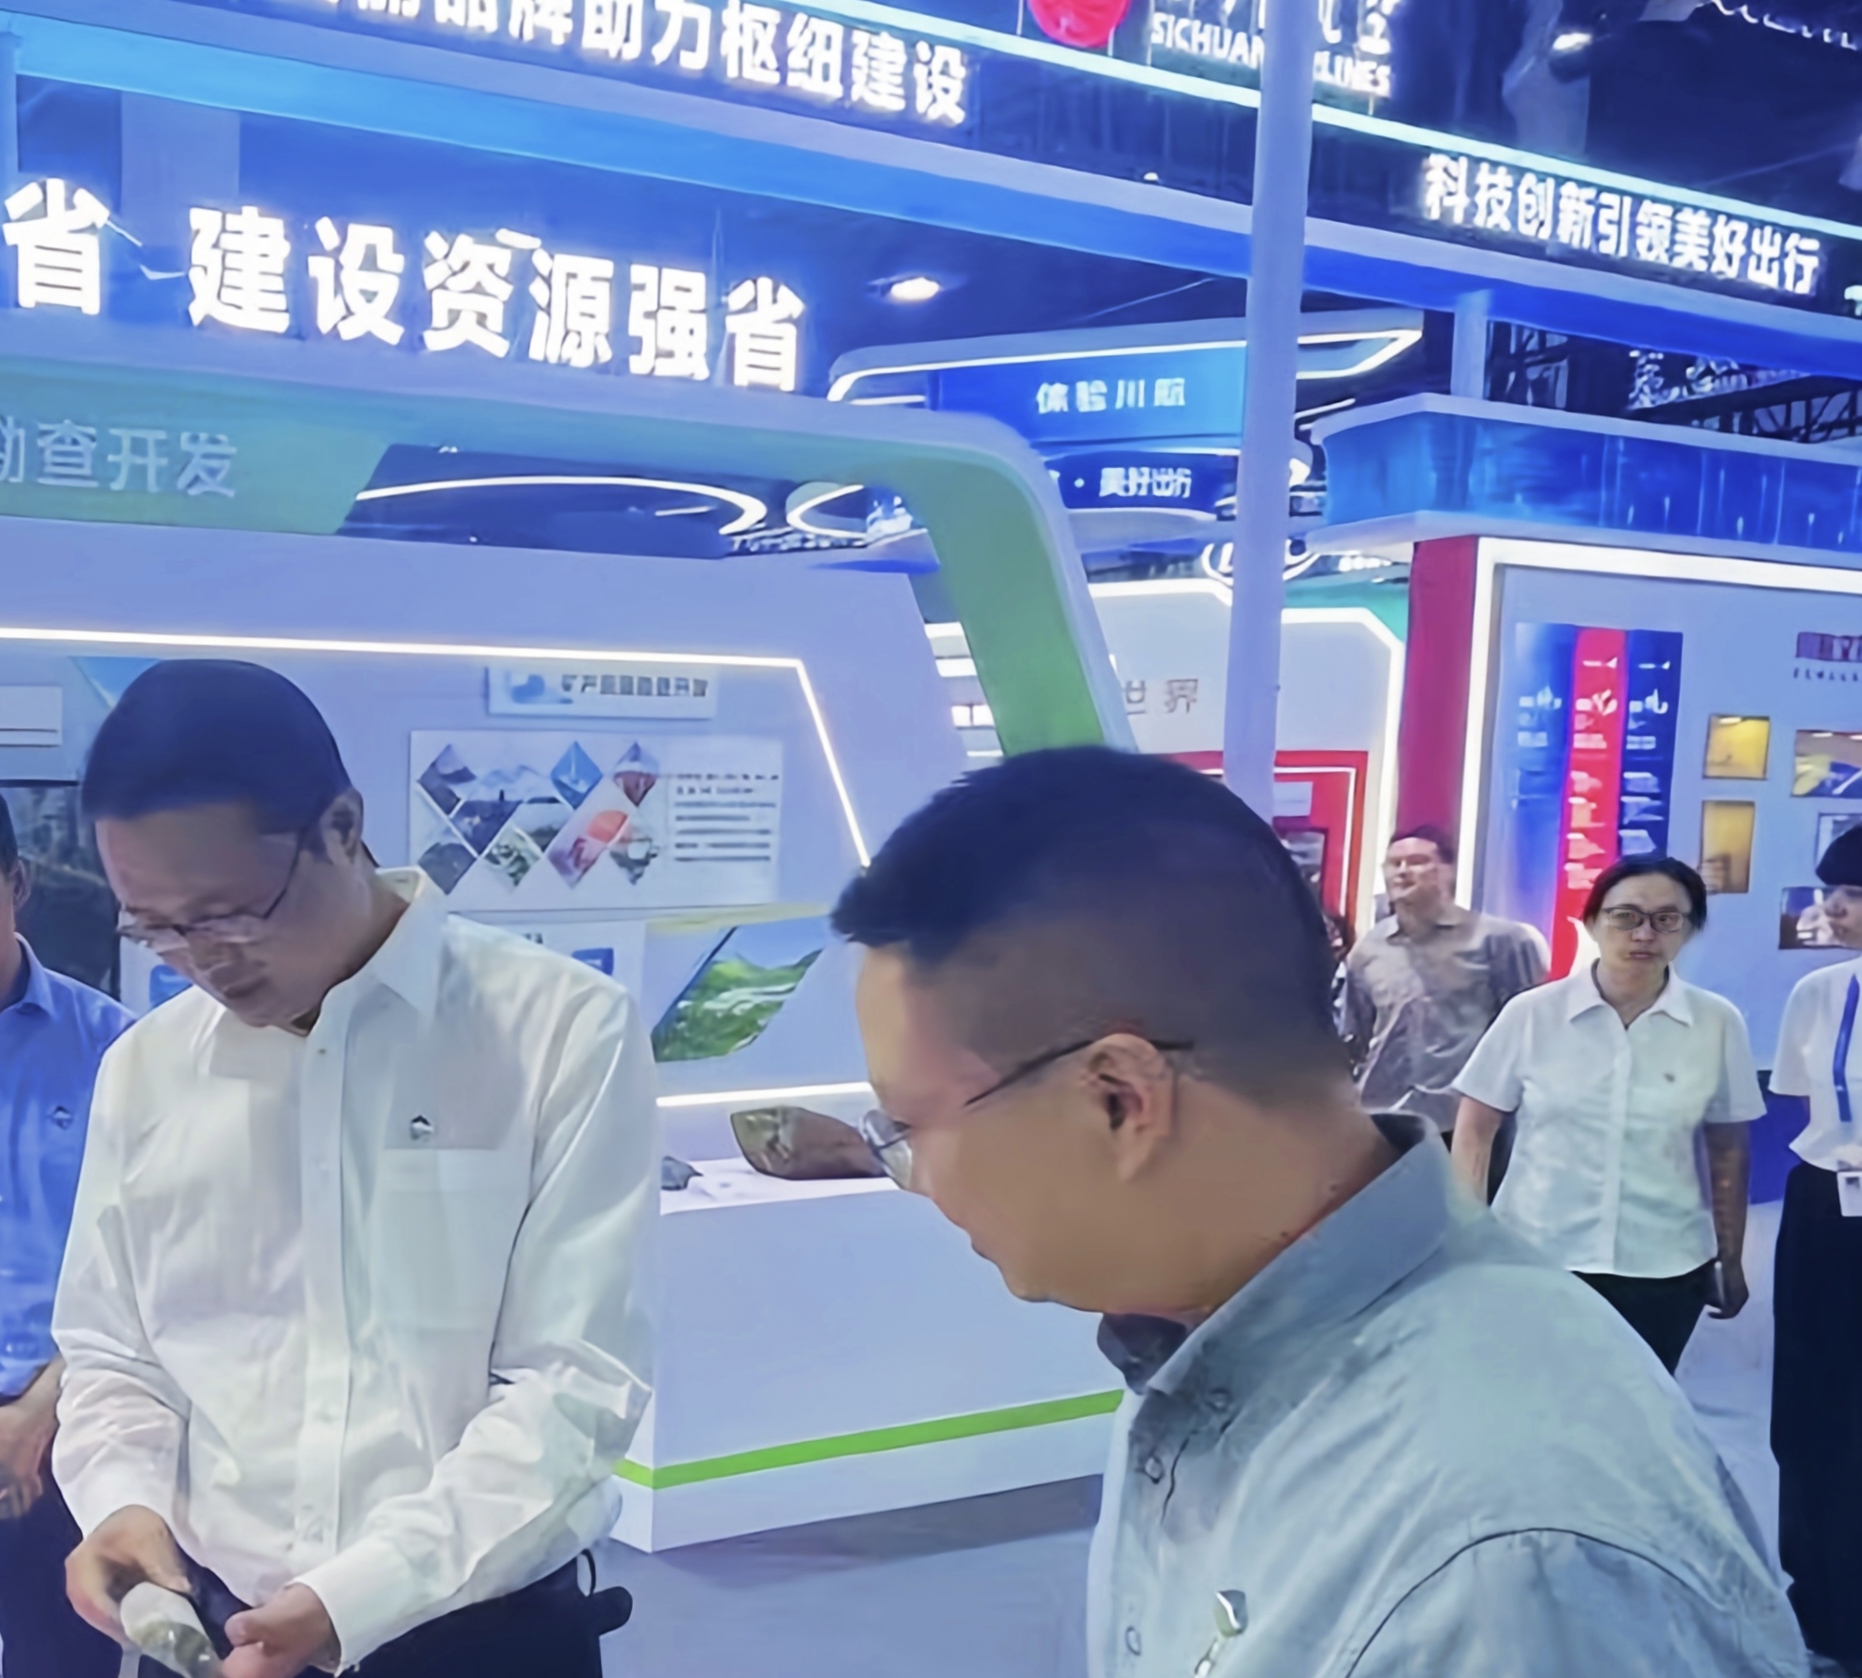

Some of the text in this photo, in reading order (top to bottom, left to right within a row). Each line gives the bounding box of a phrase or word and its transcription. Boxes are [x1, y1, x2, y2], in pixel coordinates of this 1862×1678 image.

[355, 0, 967, 128] 牌助力枢纽建设
[1151, 12, 1266, 70] SICHUAN
[1312, 50, 1392, 98] LINES
[1424, 152, 1822, 295] 科技创新引领美好出行
[187, 204, 807, 392] 建设资源强省
